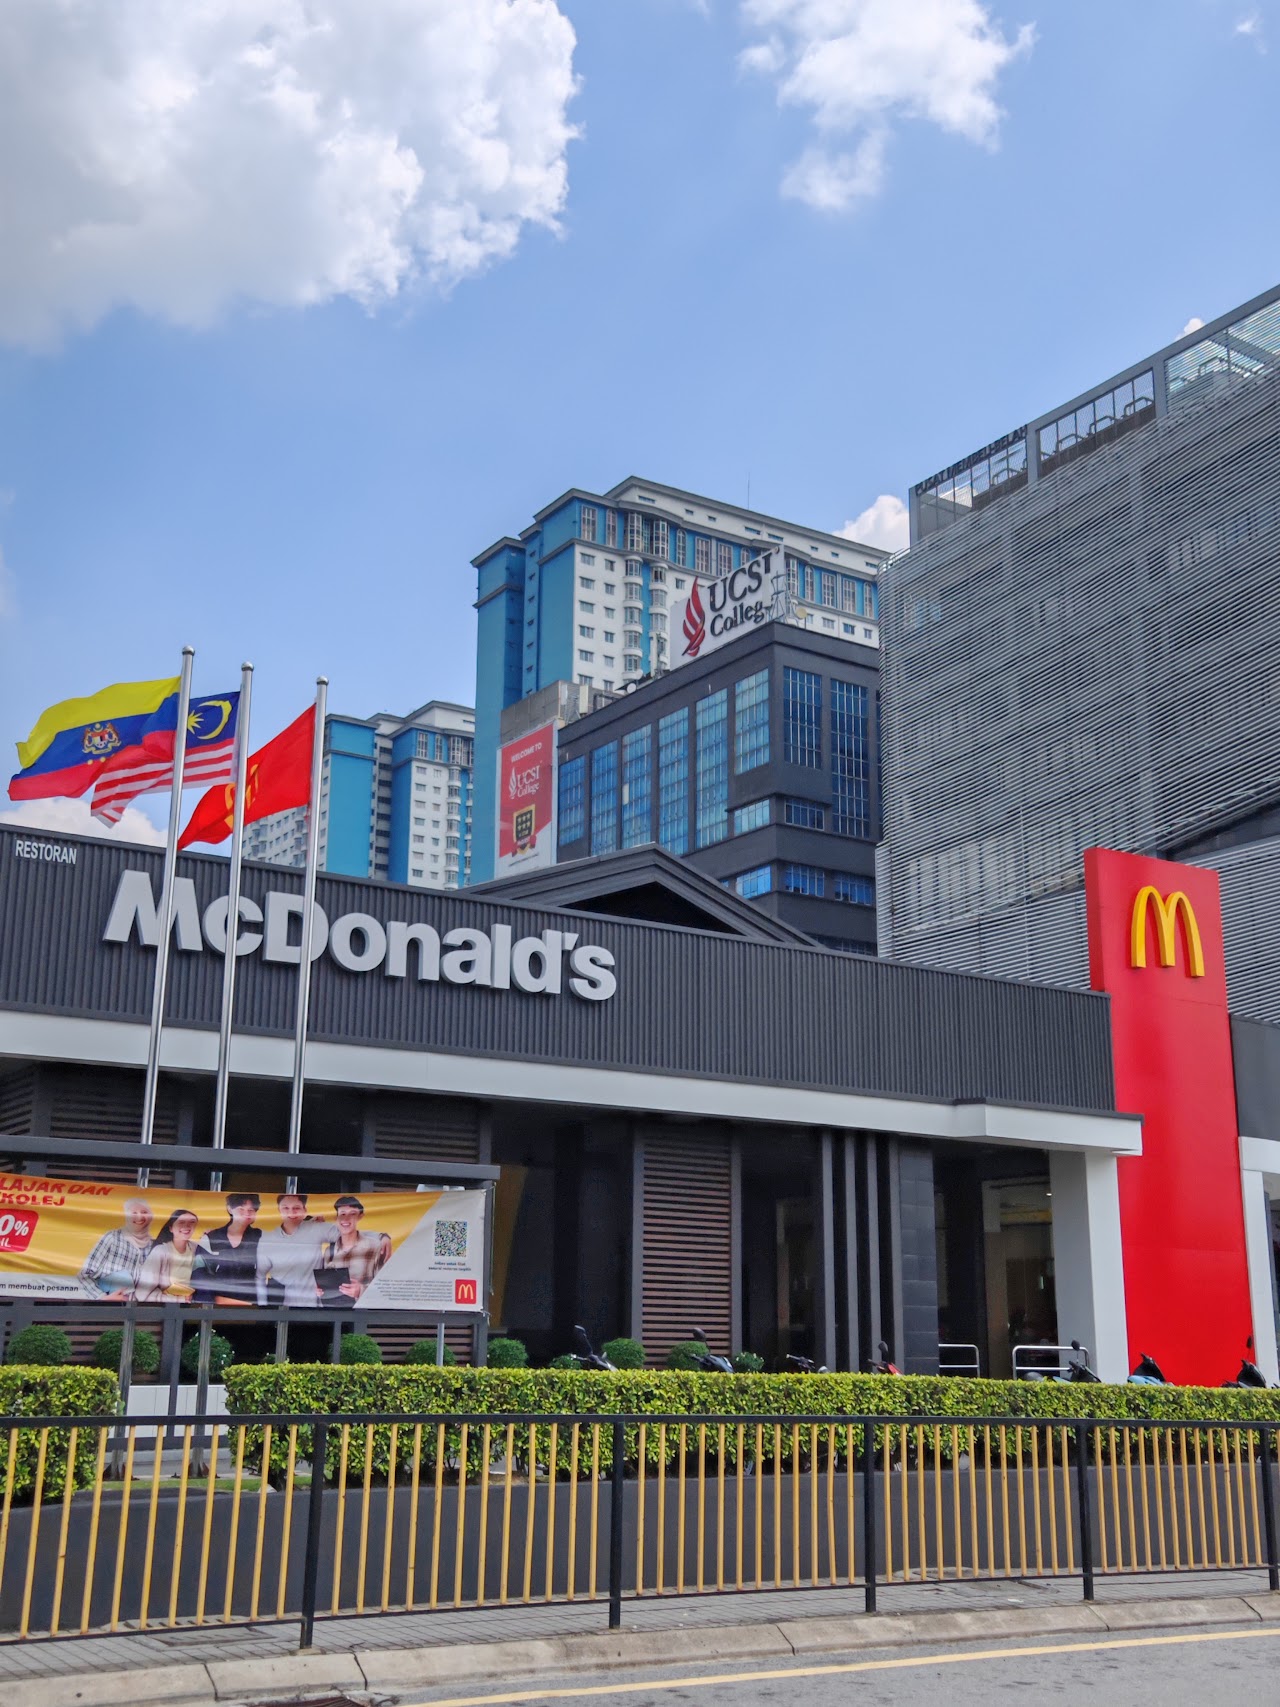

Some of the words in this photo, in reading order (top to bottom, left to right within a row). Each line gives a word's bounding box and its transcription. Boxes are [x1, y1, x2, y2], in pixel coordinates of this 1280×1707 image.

[707, 551, 773, 612] UCSI
[710, 600, 766, 637] Colleg
[511, 745, 534, 763] WELCOME
[534, 741, 543, 752] TO
[517, 764, 540, 788] UCSI
[517, 781, 540, 798] College
[15, 839, 77, 865] RESTORAN
[102, 868, 617, 1002] McDonald's
[0, 1177, 66, 1194] LAJAR
[67, 1183, 114, 1197] DAN
[0, 1192, 66, 1207] KOLEJ
[0, 1237, 12, 1248] IL
[8, 1283, 46, 1291] membuat
[46, 1284, 79, 1293] pesanan
